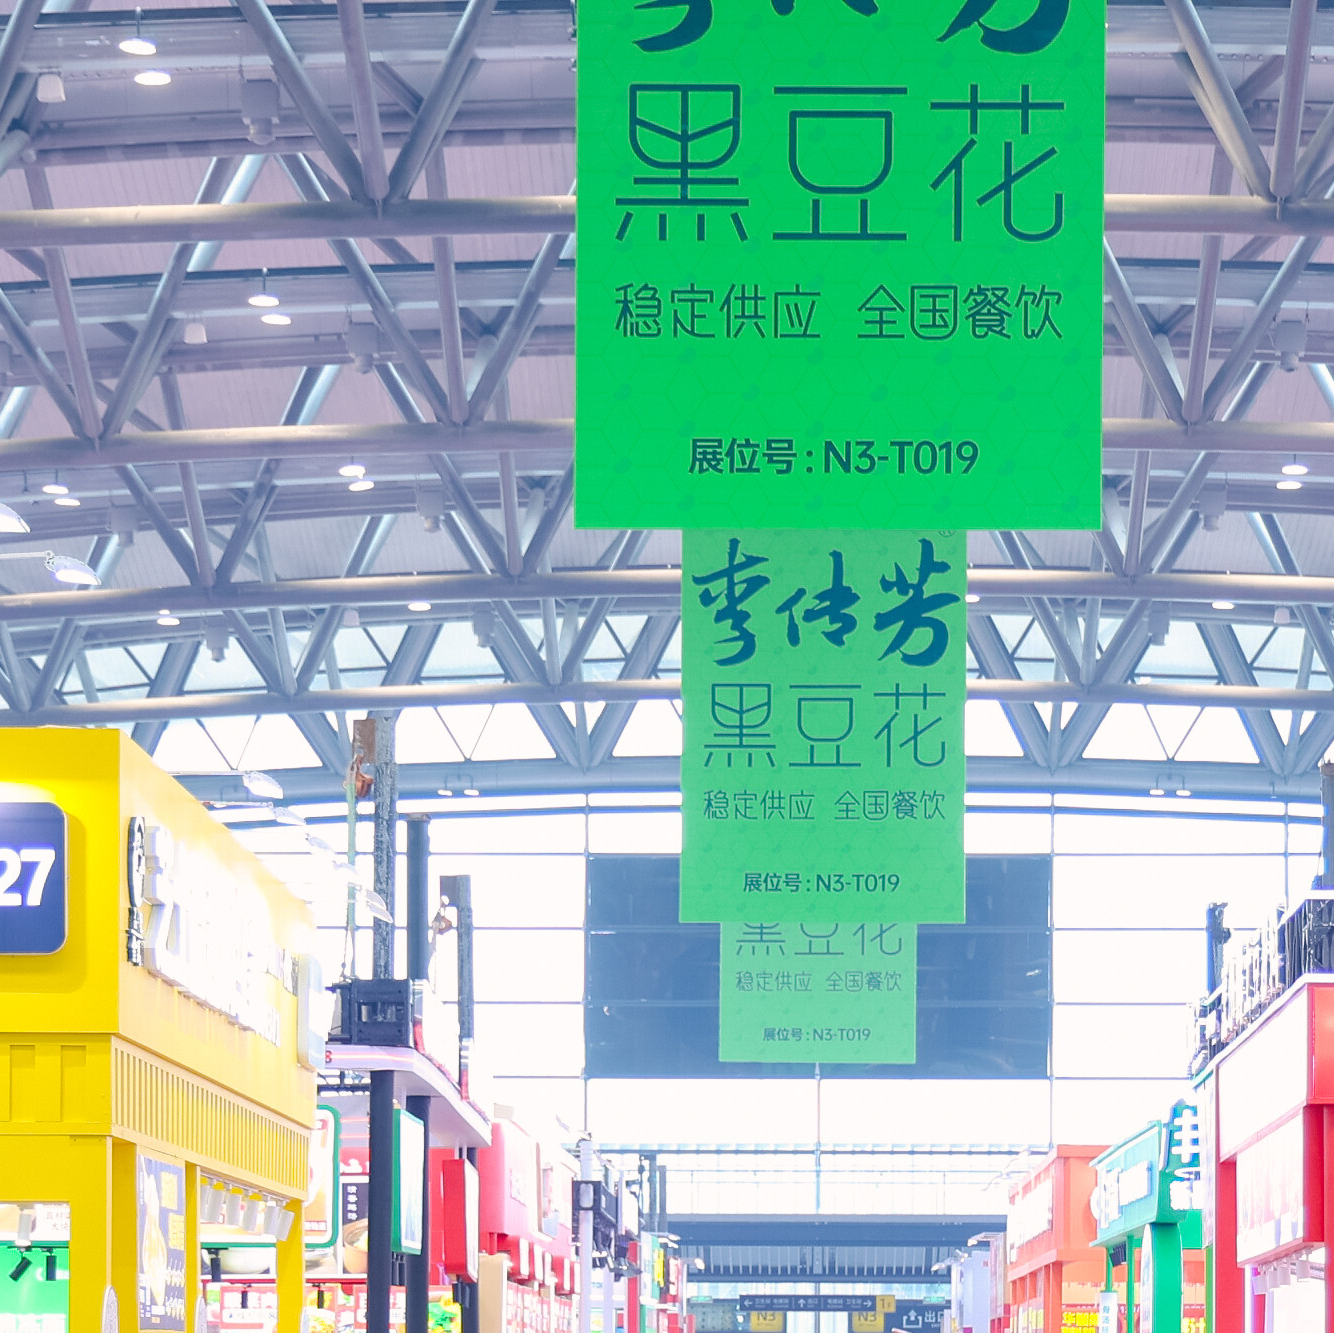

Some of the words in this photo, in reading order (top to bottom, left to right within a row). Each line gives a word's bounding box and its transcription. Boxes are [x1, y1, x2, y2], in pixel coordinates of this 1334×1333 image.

[615, 82, 1065, 243] 黑豆花
[615, 283, 821, 339] 稳定供应
[857, 284, 1063, 340] 全国餐饮
[692, 537, 961, 667] 李传芳
[703, 683, 947, 768] 黑豆花
[704, 790, 815, 821] 稳定供应
[834, 790, 946, 822] 全国餐饮
[735, 971, 812, 992] 稳定供应
[825, 971, 902, 992] 全国餐饮
